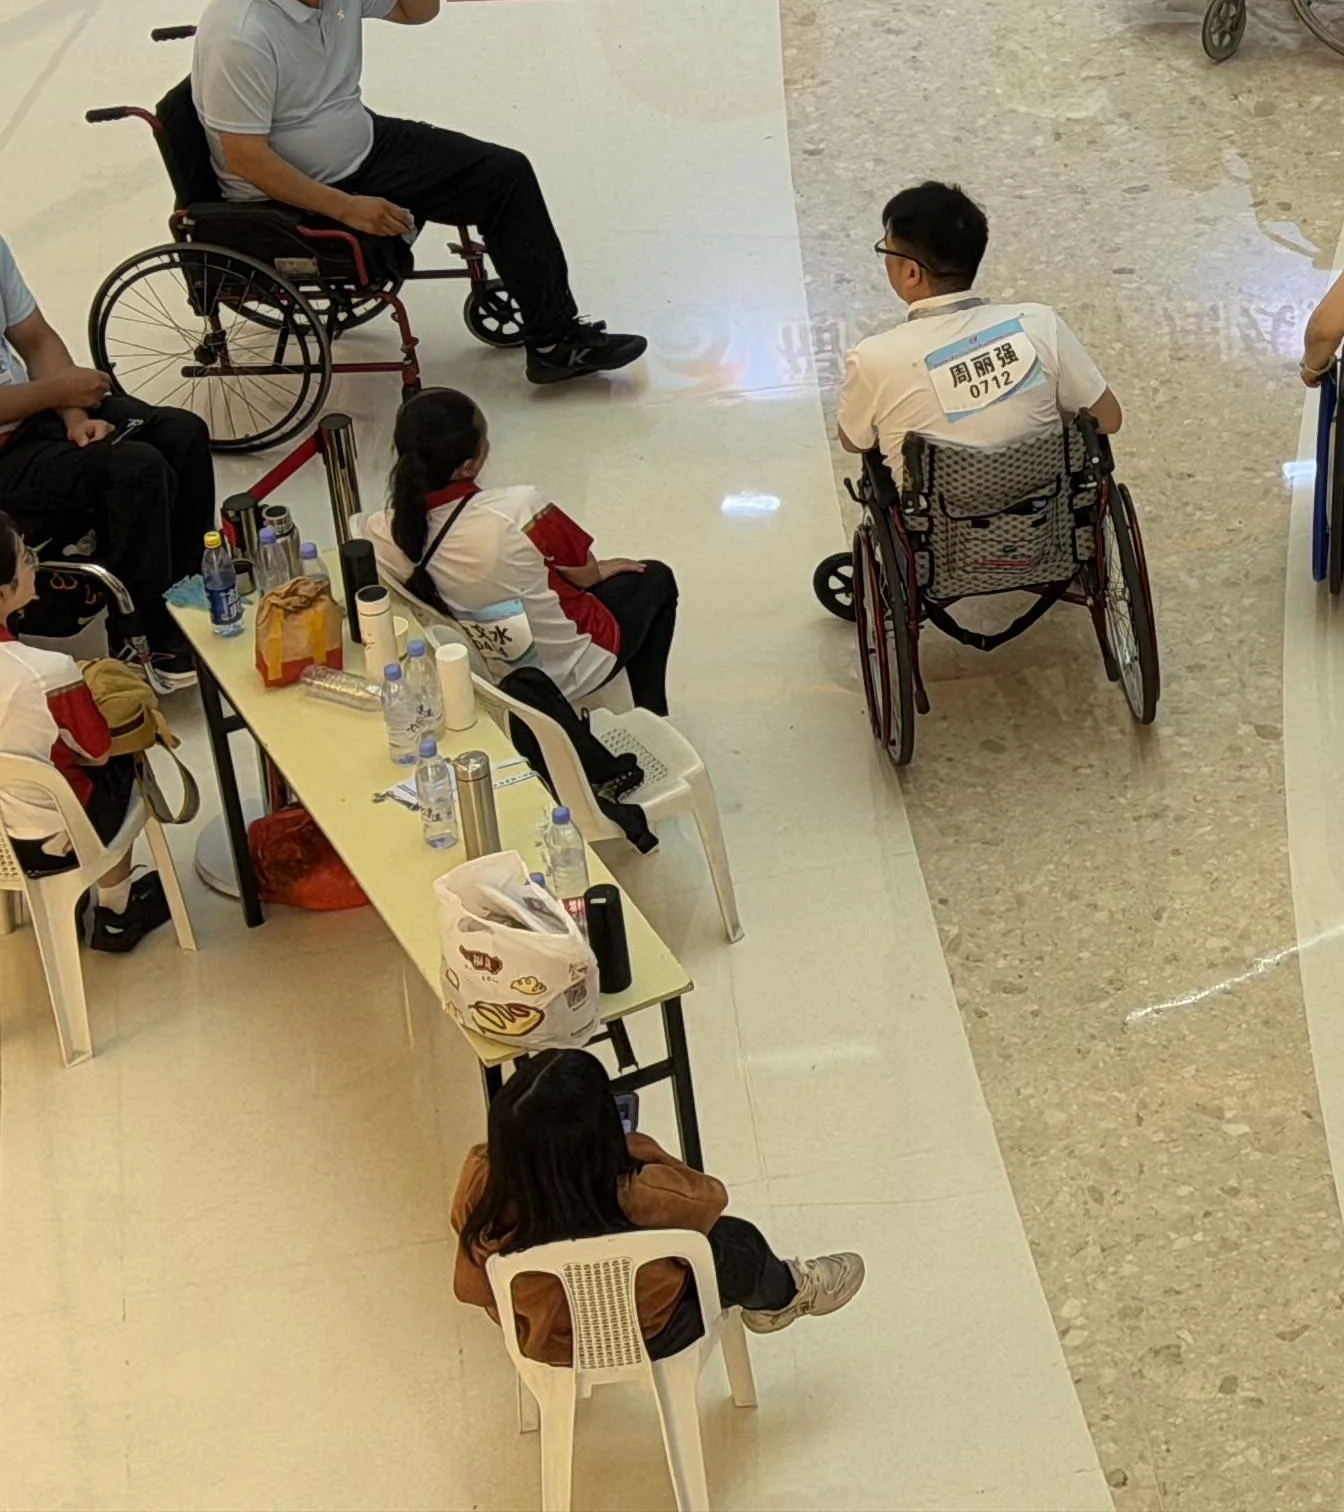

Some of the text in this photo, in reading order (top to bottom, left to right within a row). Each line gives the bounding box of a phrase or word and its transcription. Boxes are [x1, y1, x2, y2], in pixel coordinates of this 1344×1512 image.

[949, 342, 1020, 389] 周丽强
[968, 370, 1014, 399] 0712
